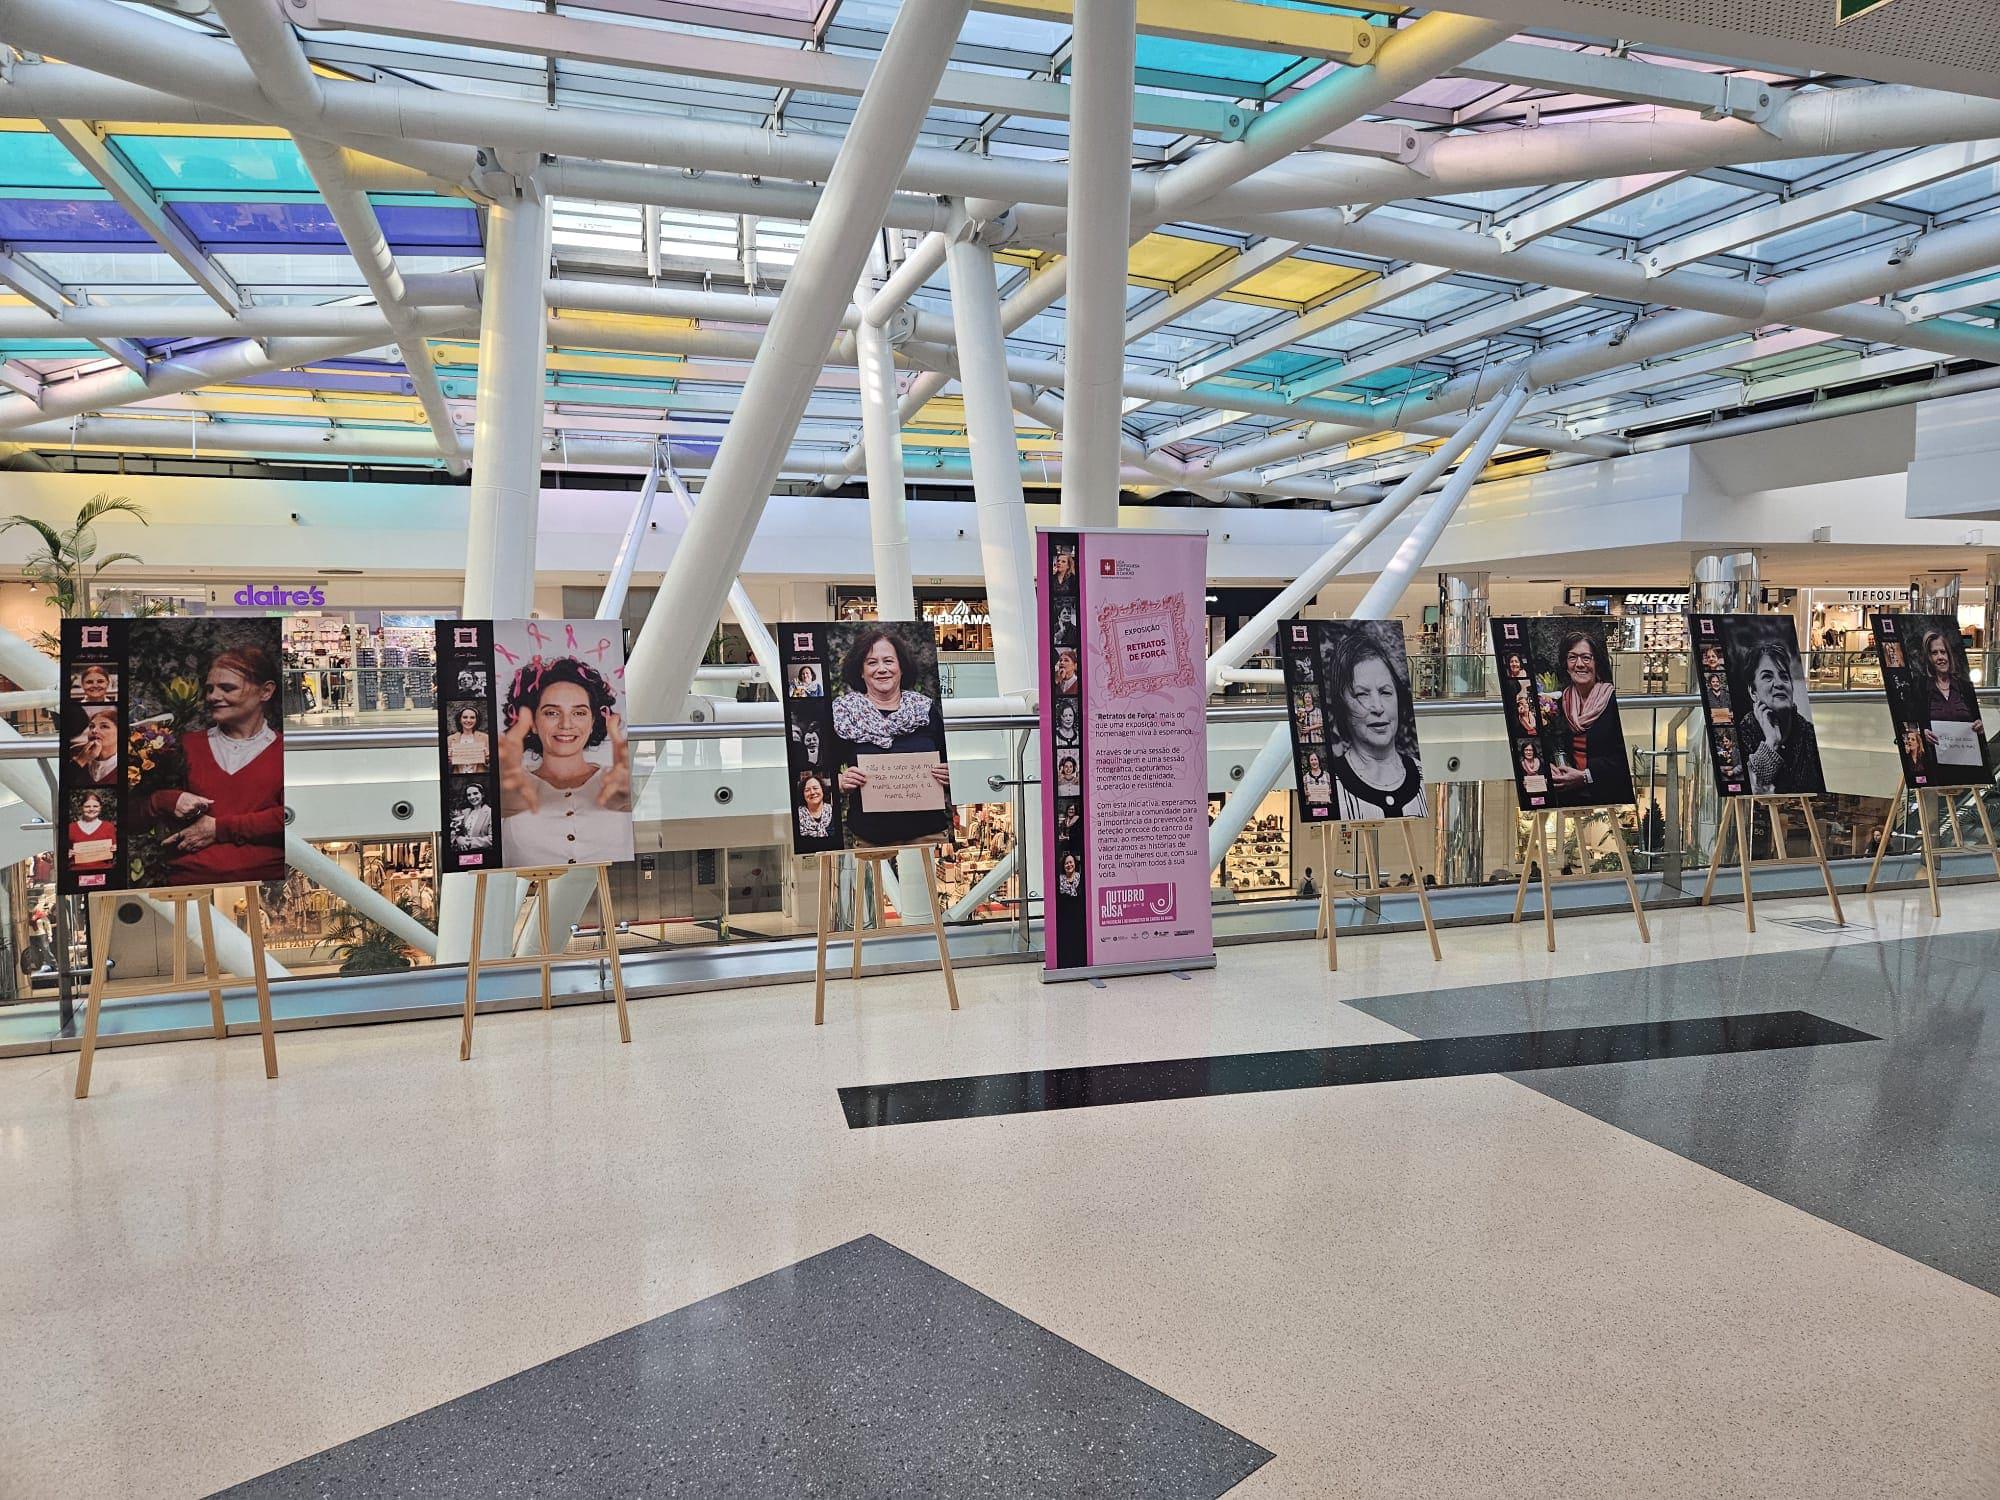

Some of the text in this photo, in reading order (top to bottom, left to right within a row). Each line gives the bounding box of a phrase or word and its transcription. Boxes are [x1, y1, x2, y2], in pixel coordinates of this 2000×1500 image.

[234, 584, 325, 606] claire's
[1848, 590, 1896, 600] TIFFOSI
[1125, 625, 1160, 636] EXPOSIÇÃO
[1127, 639, 1166, 652] RETRATOS
[1129, 649, 1167, 661] DE FORÇA
[1106, 888, 1144, 904] OUTUBRO
[1101, 904, 1123, 918] ROSA
